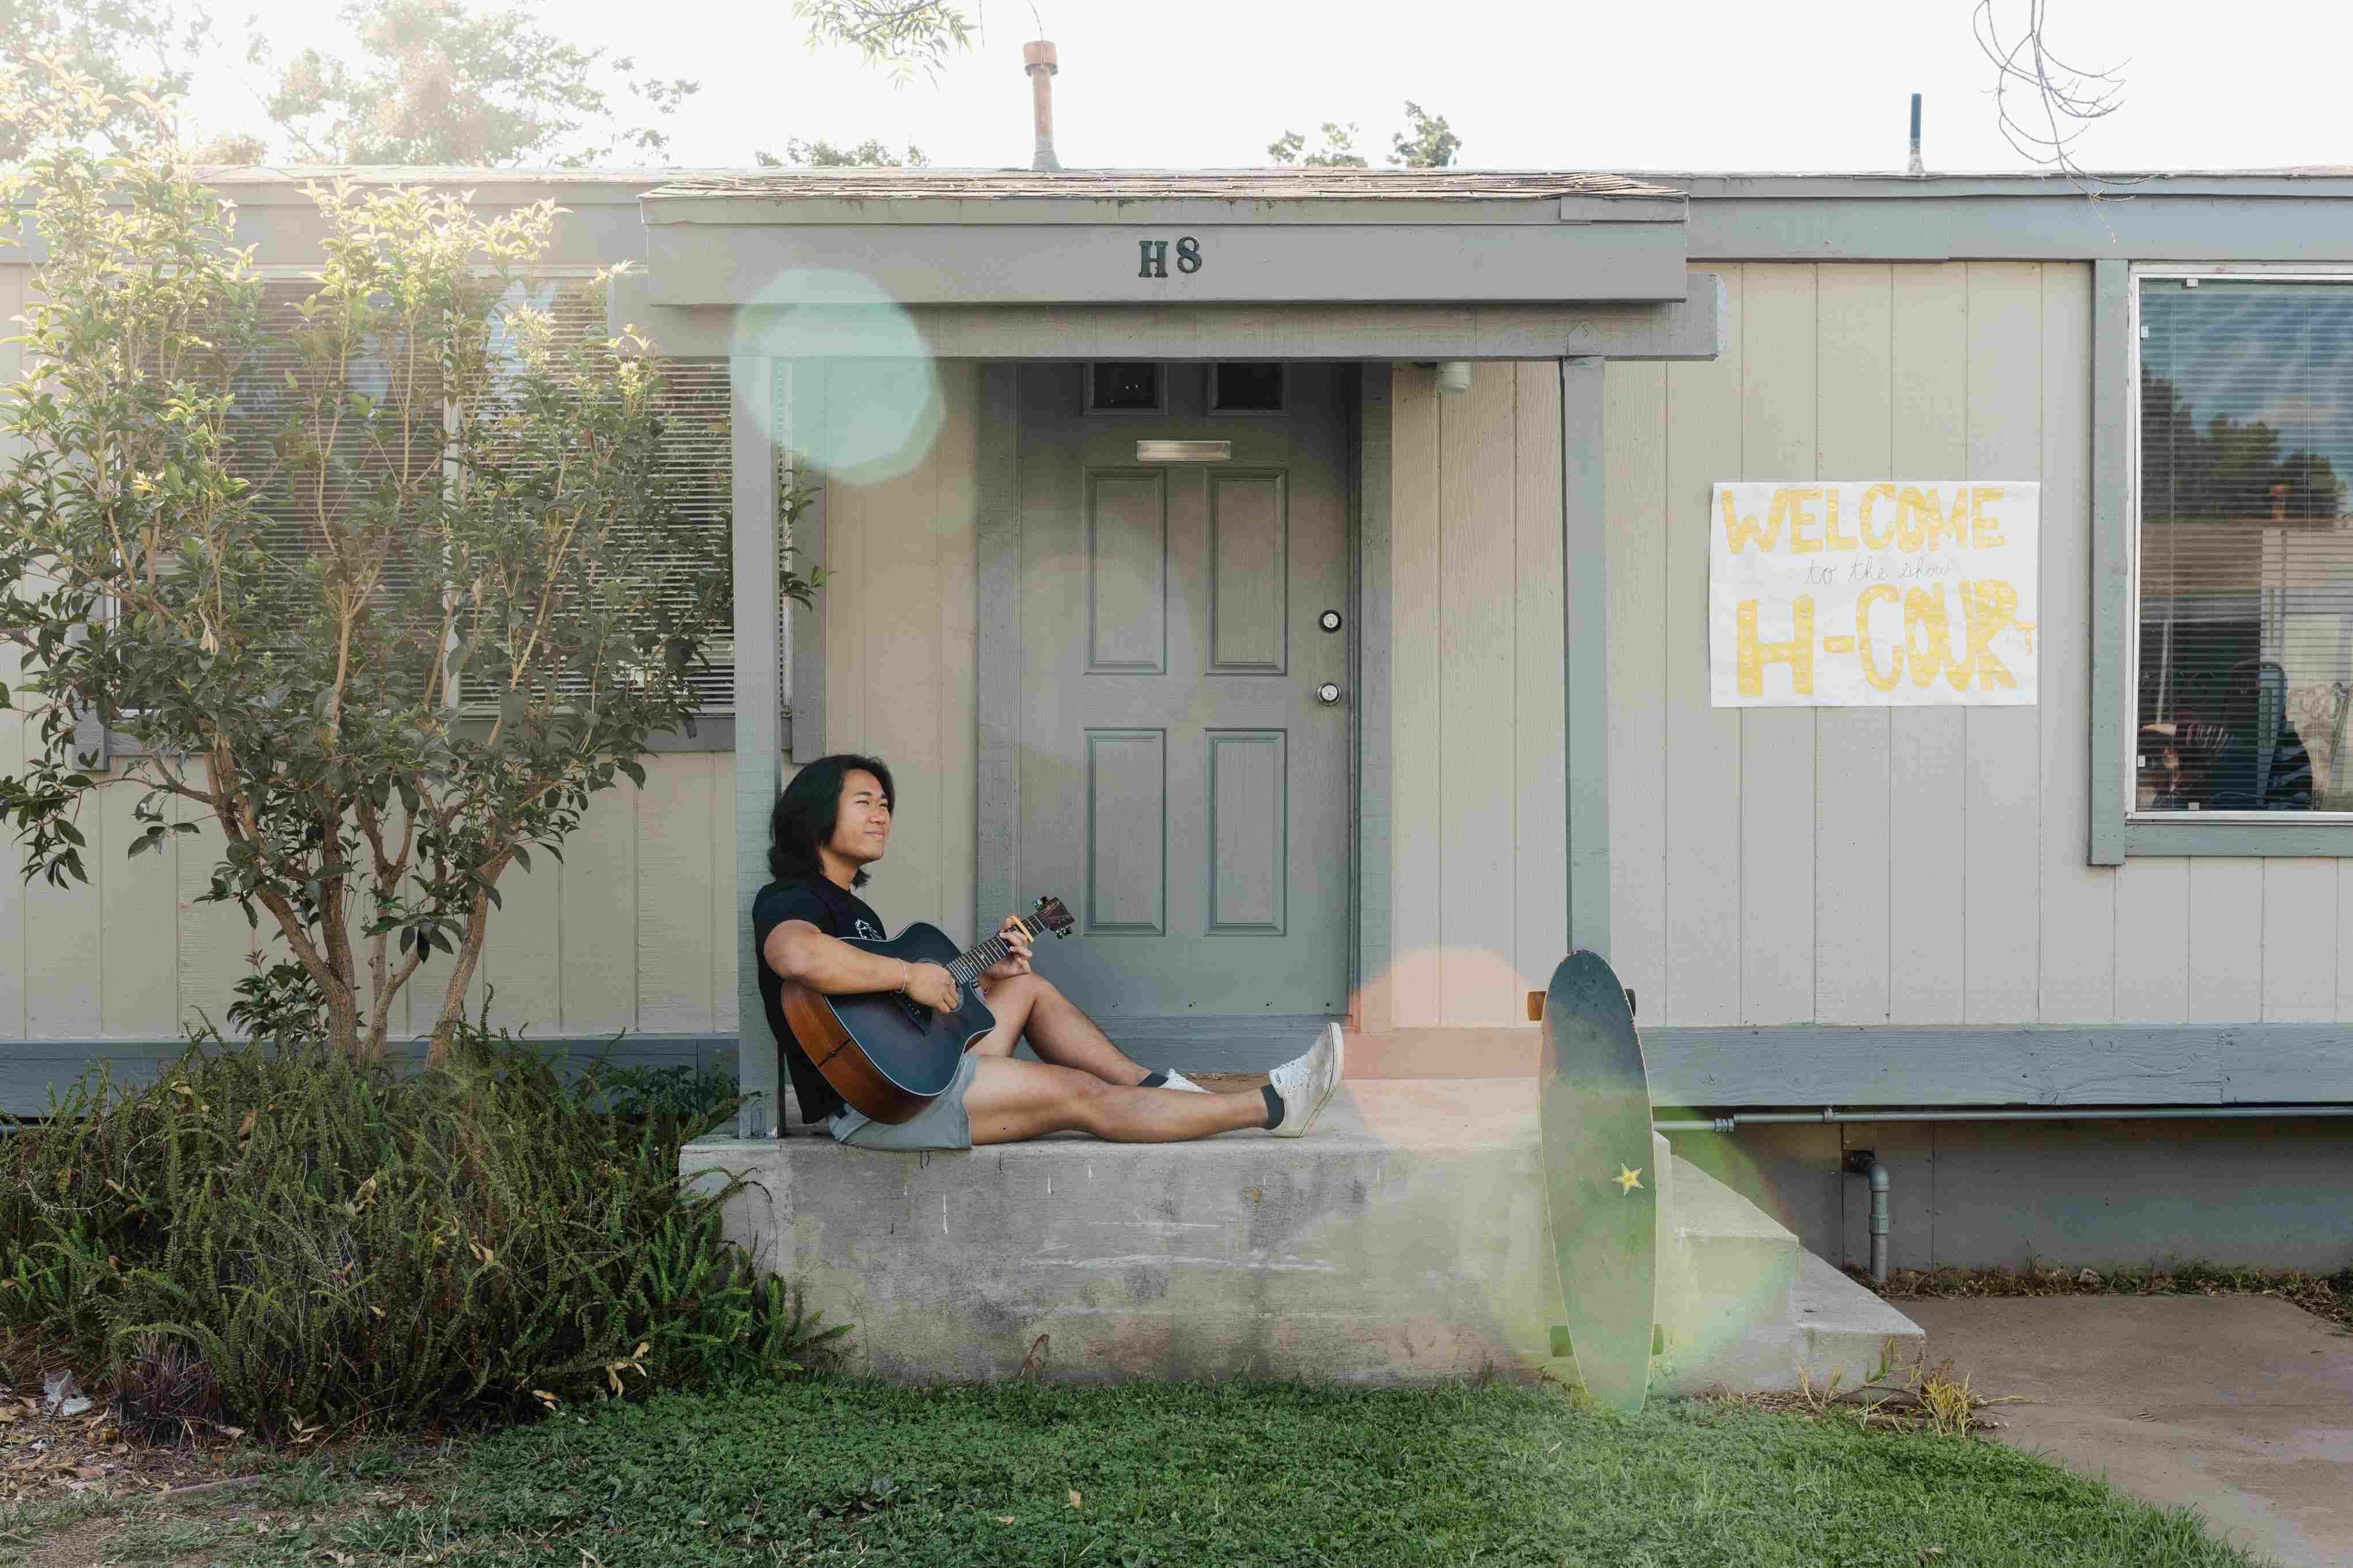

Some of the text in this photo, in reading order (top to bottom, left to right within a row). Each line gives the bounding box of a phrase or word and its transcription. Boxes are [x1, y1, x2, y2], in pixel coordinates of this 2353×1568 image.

[1138, 236, 1202, 277] H8
[1721, 483, 2006, 554] WELCOME
[1805, 558, 1838, 585] to
[1847, 552, 1889, 584] the
